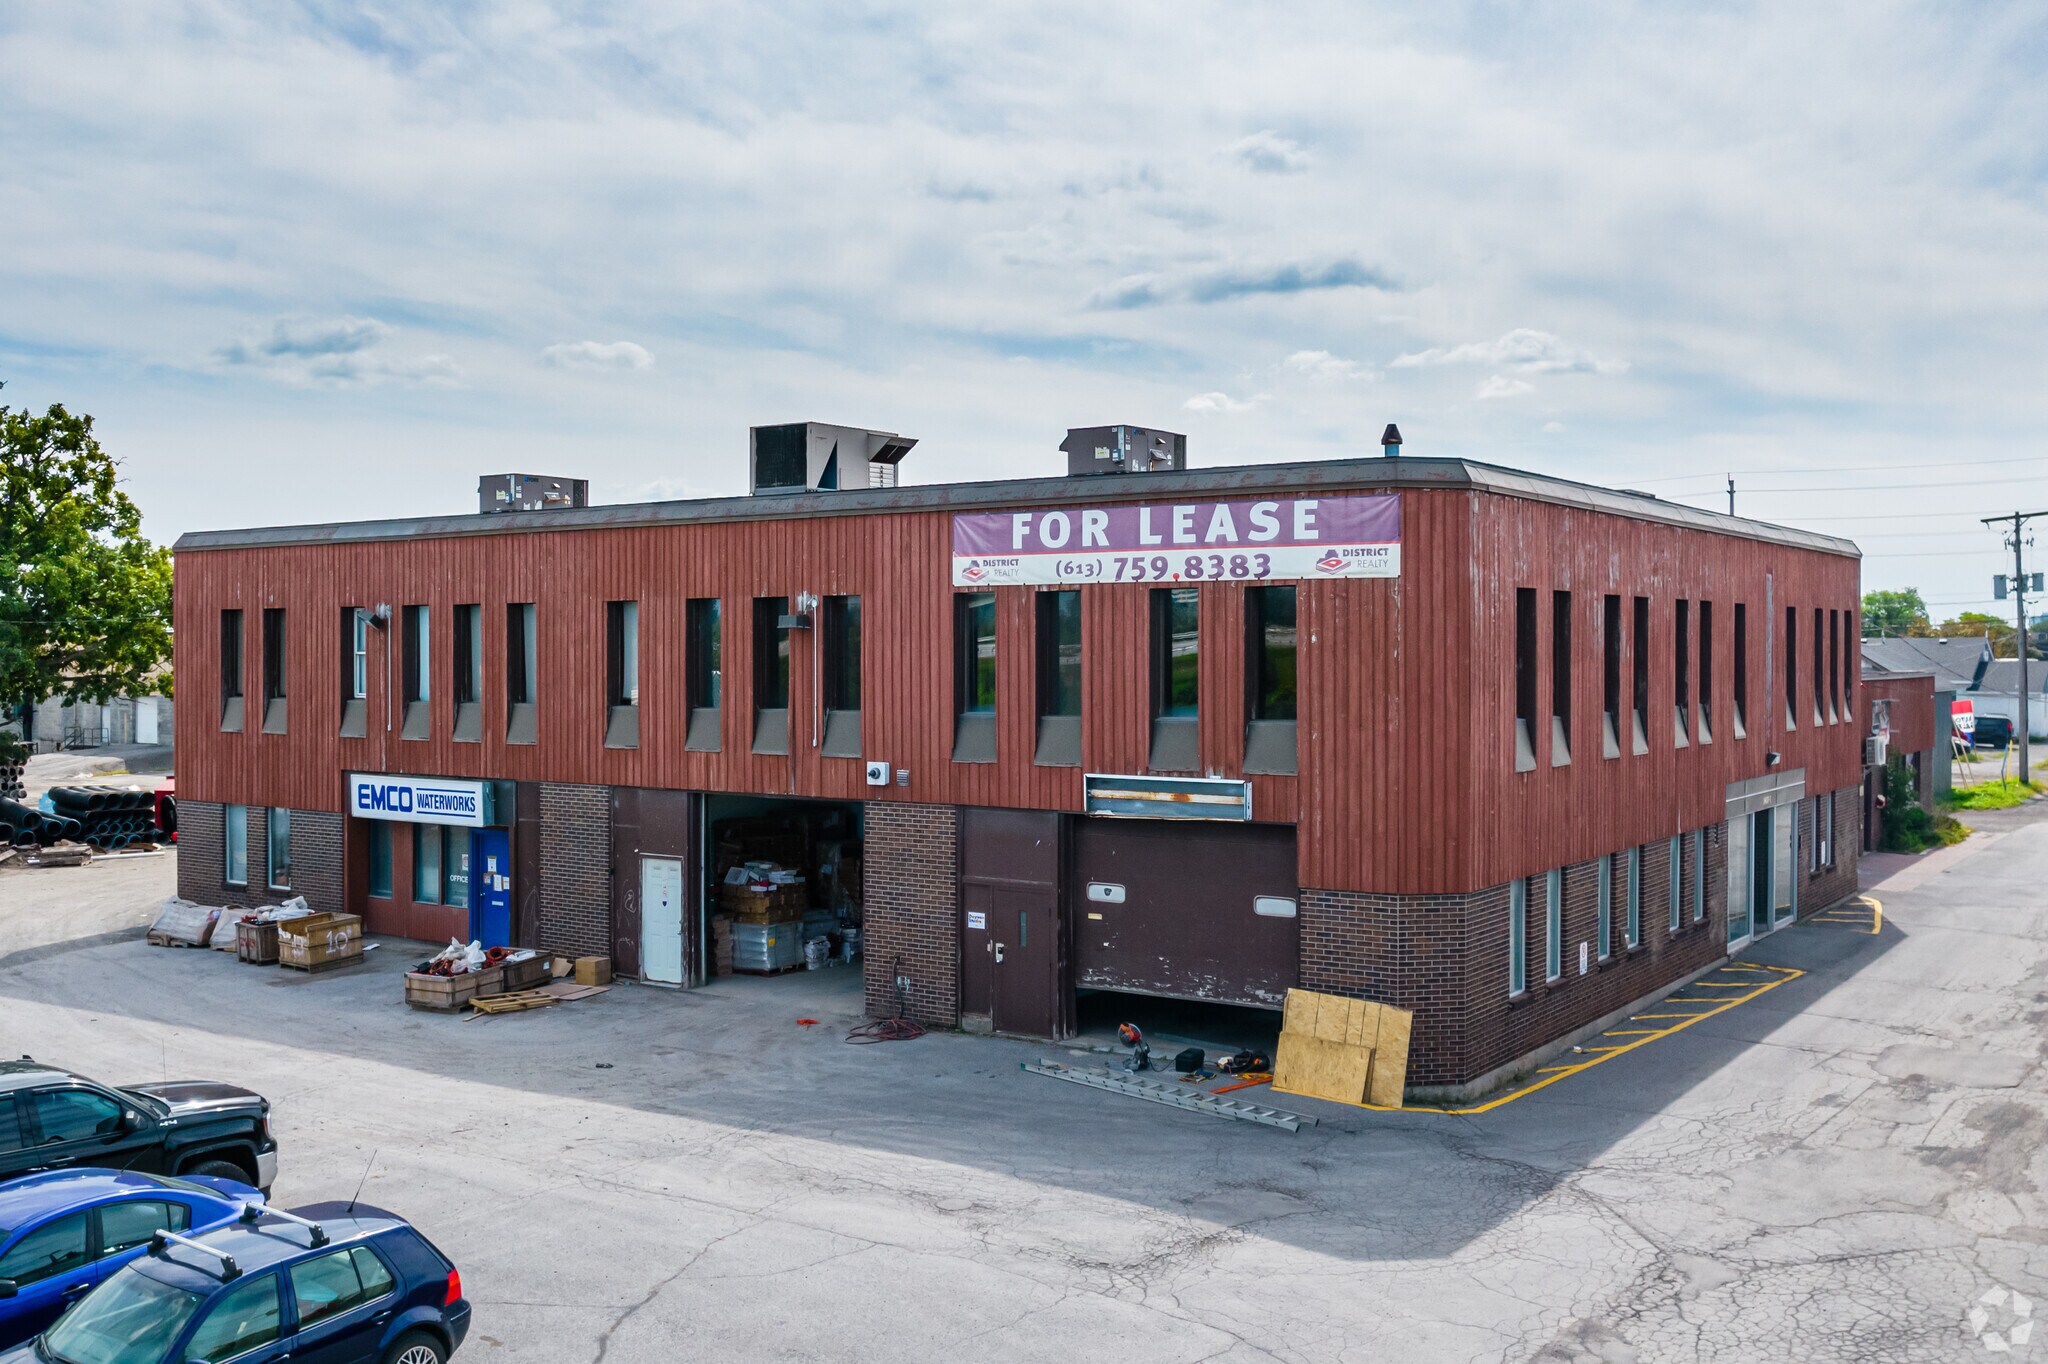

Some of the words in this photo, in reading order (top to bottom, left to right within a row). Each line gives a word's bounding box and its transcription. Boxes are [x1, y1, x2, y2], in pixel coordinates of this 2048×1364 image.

[1012, 509, 1110, 550] FOR
[1139, 500, 1319, 545] LEASE
[1342, 547, 1389, 557] DISTRICT
[982, 558, 1020, 567] DISTRICT
[1056, 558, 1103, 578] (613)
[1113, 553, 1271, 582] 759.8383
[1357, 559, 1389, 569] REALTY
[993, 568, 1019, 577] REALTY
[358, 783, 413, 813] EMCO
[416, 793, 476, 813] WATERWORKS
[450, 874, 469, 884] OFFICE
